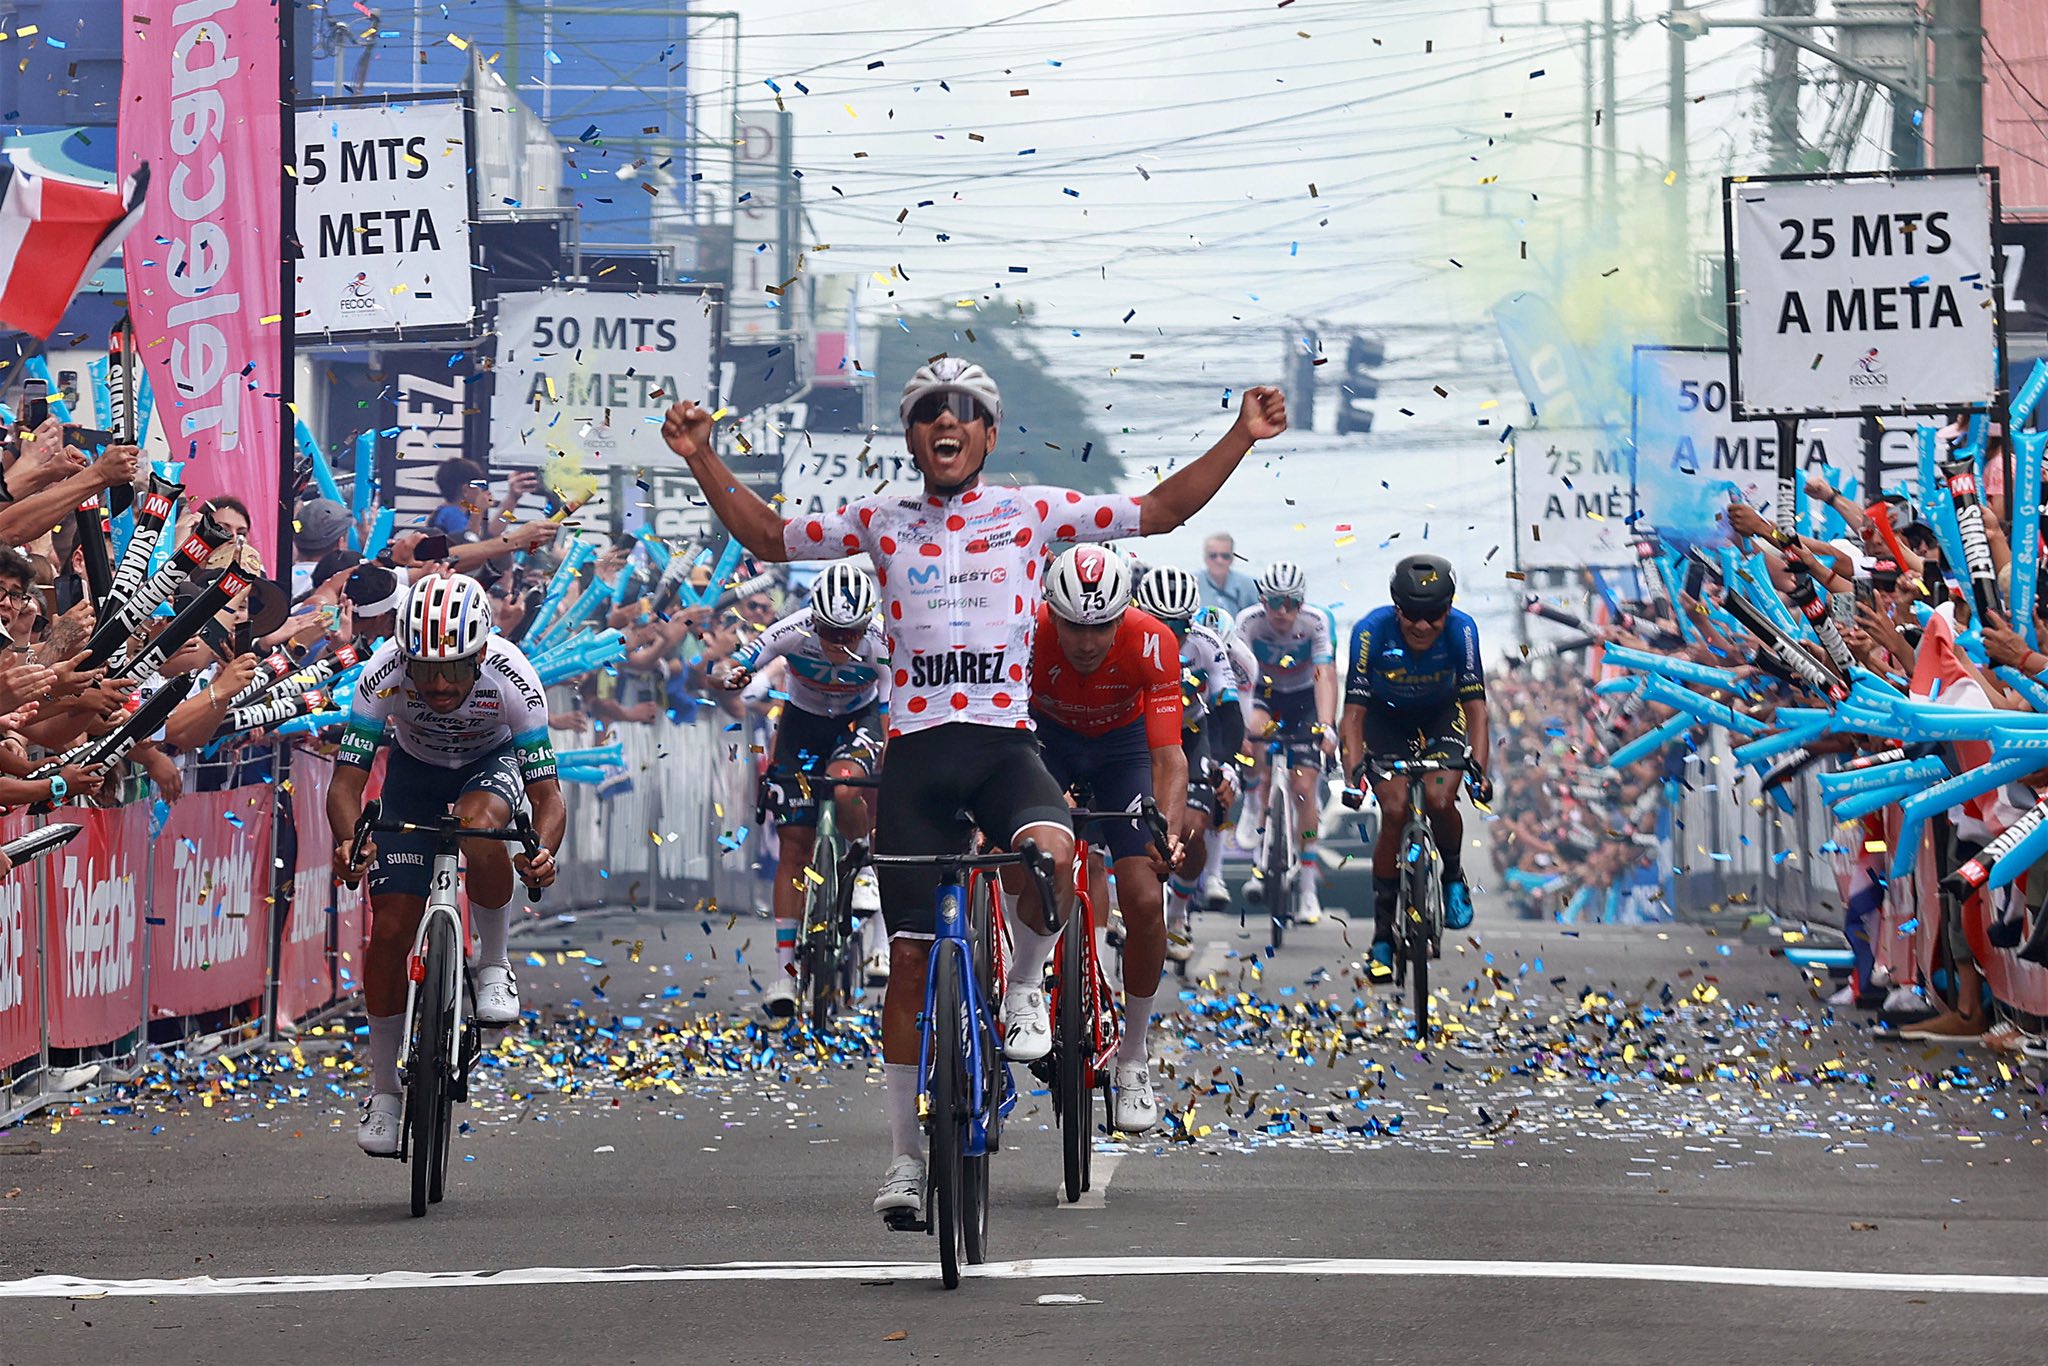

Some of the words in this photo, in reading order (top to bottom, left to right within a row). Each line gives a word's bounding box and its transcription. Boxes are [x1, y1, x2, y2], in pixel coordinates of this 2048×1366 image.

[297, 144, 327, 186] 5
[341, 136, 430, 183] MTS
[319, 208, 441, 258] META
[1780, 218, 1836, 260] 25
[1852, 211, 1952, 258] MTS
[1777, 291, 1811, 334] A
[1826, 285, 1963, 333] META
[533, 316, 584, 350] 50
[594, 317, 677, 352] MTS
[566, 373, 680, 409] META
[1678, 379, 1727, 412] 50
[394, 373, 466, 530] UAREZ
[813, 453, 847, 478] 75
[1670, 435, 1700, 469] A
[1713, 435, 1829, 471] MEA
[1543, 494, 1566, 519] A
[1957, 504, 1996, 584] SUAREZ
[107, 525, 159, 605] SUAREZ
[949, 571, 990, 585] BEST
[115, 560, 188, 634] SUAREZ
[1079, 591, 1106, 612] 75
[360, 658, 399, 704] Manza
[486, 652, 527, 696] Manza
[911, 651, 1006, 688] SUAREZ
[474, 689, 498, 699] SUAREZ
[233, 697, 297, 731] SUAREZ
[336, 751, 362, 765] AREZ
[341, 731, 375, 753] elva
[525, 764, 557, 781] SUAREZ
[1983, 802, 2048, 864] SUAREZ
[387, 852, 425, 866] SUAREZ
